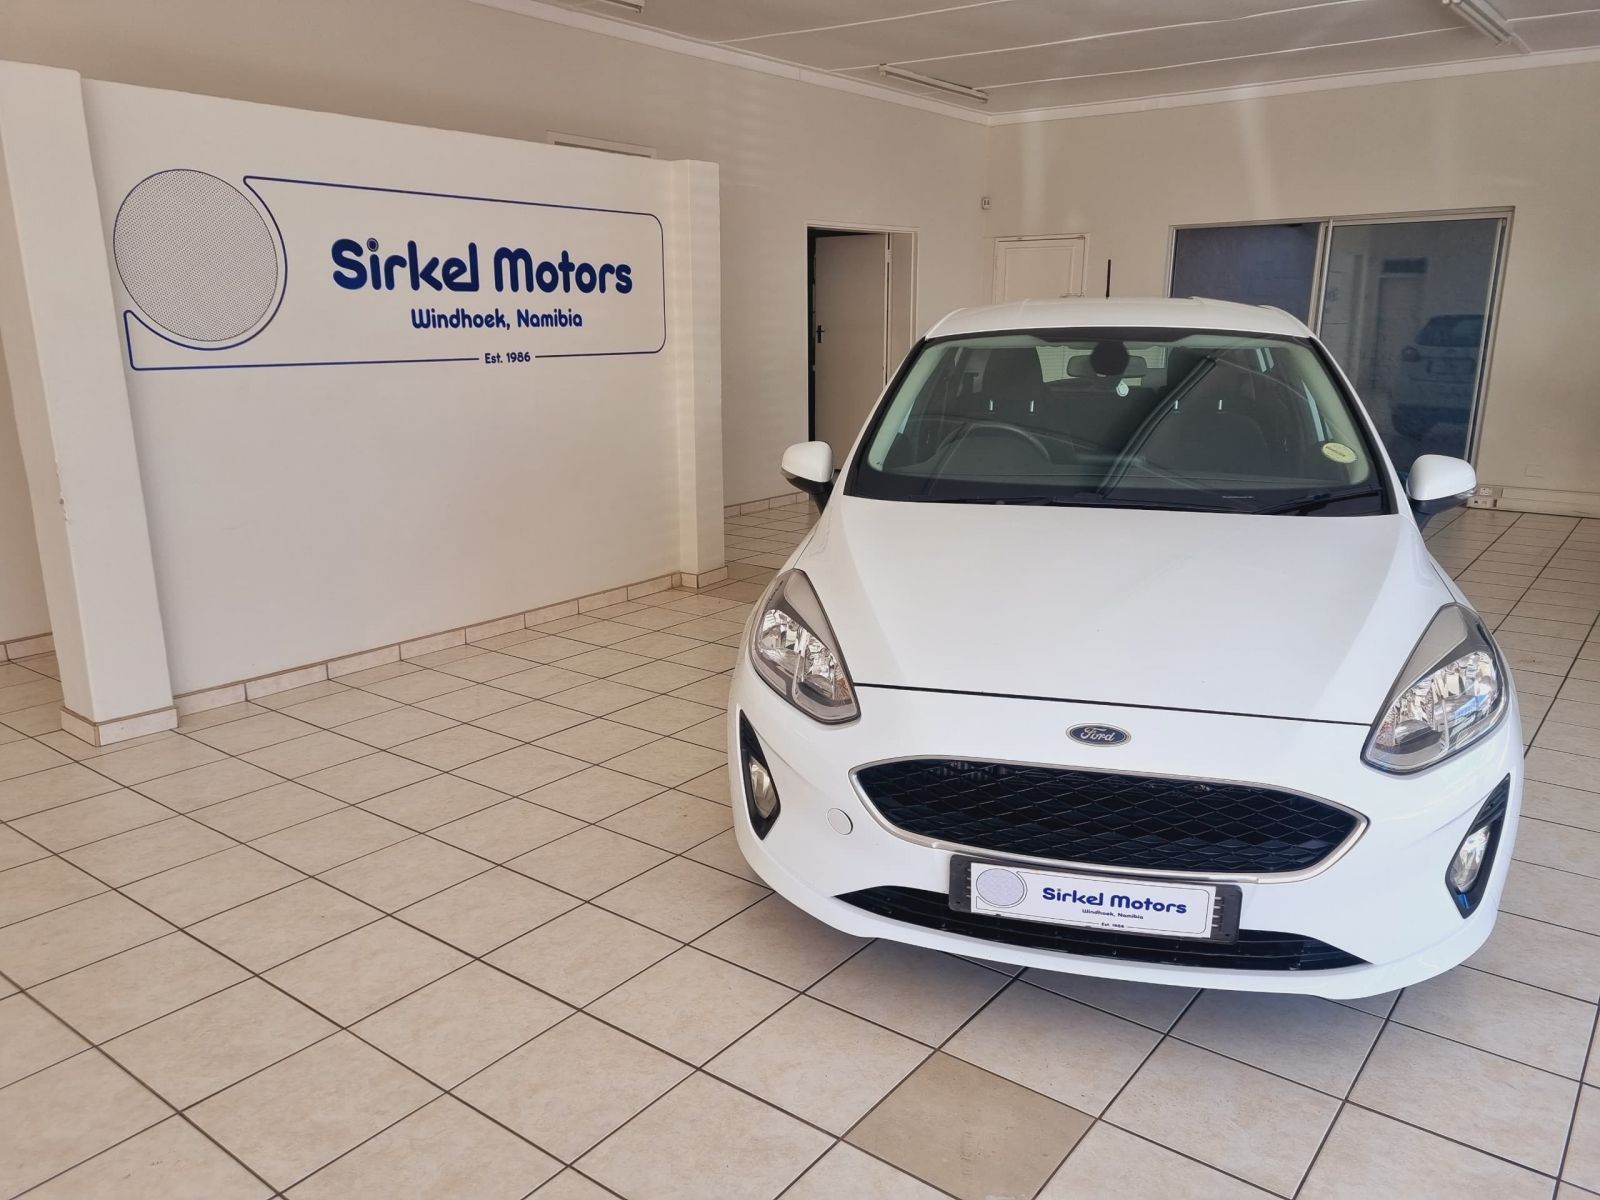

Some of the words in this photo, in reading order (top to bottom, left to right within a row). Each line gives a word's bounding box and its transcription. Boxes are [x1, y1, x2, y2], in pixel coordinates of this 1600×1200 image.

[331, 237, 480, 292] Sirkel
[493, 246, 633, 294] Motors
[411, 308, 511, 331] Windhoek,
[517, 308, 583, 328] Namibia
[484, 352, 503, 364] Est.
[506, 351, 531, 363] 1986
[1080, 727, 1116, 742] Ford
[1042, 887, 1104, 906] Sirkel
[1110, 894, 1187, 914] Motors
